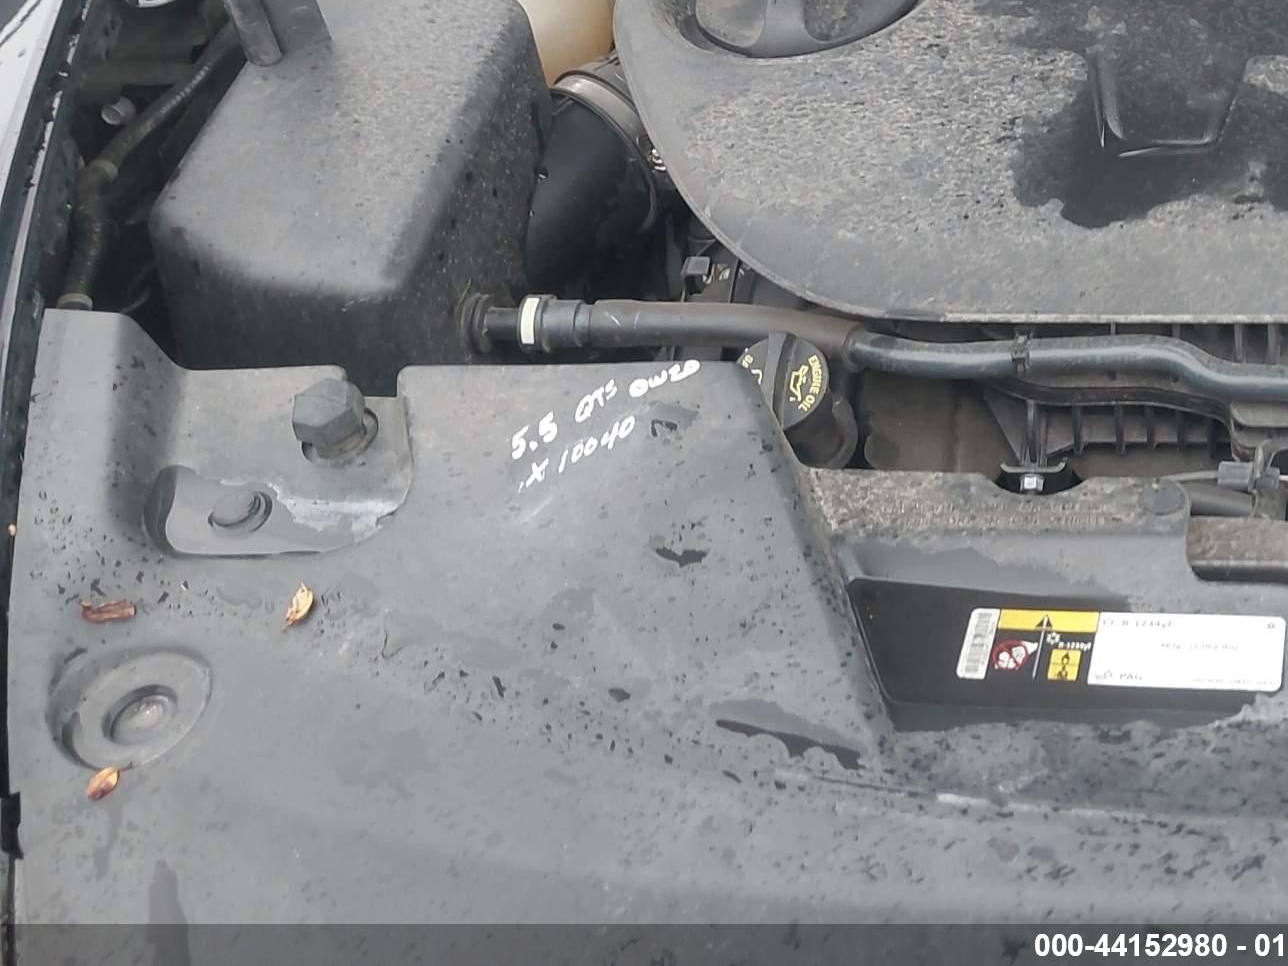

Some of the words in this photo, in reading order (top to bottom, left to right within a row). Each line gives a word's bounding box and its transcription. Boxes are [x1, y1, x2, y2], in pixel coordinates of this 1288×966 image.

[807, 354, 823, 395] ENGINE
[797, 393, 816, 412] OIL
[510, 410, 559, 460] 5.5
[557, 415, 636, 474] 10040
